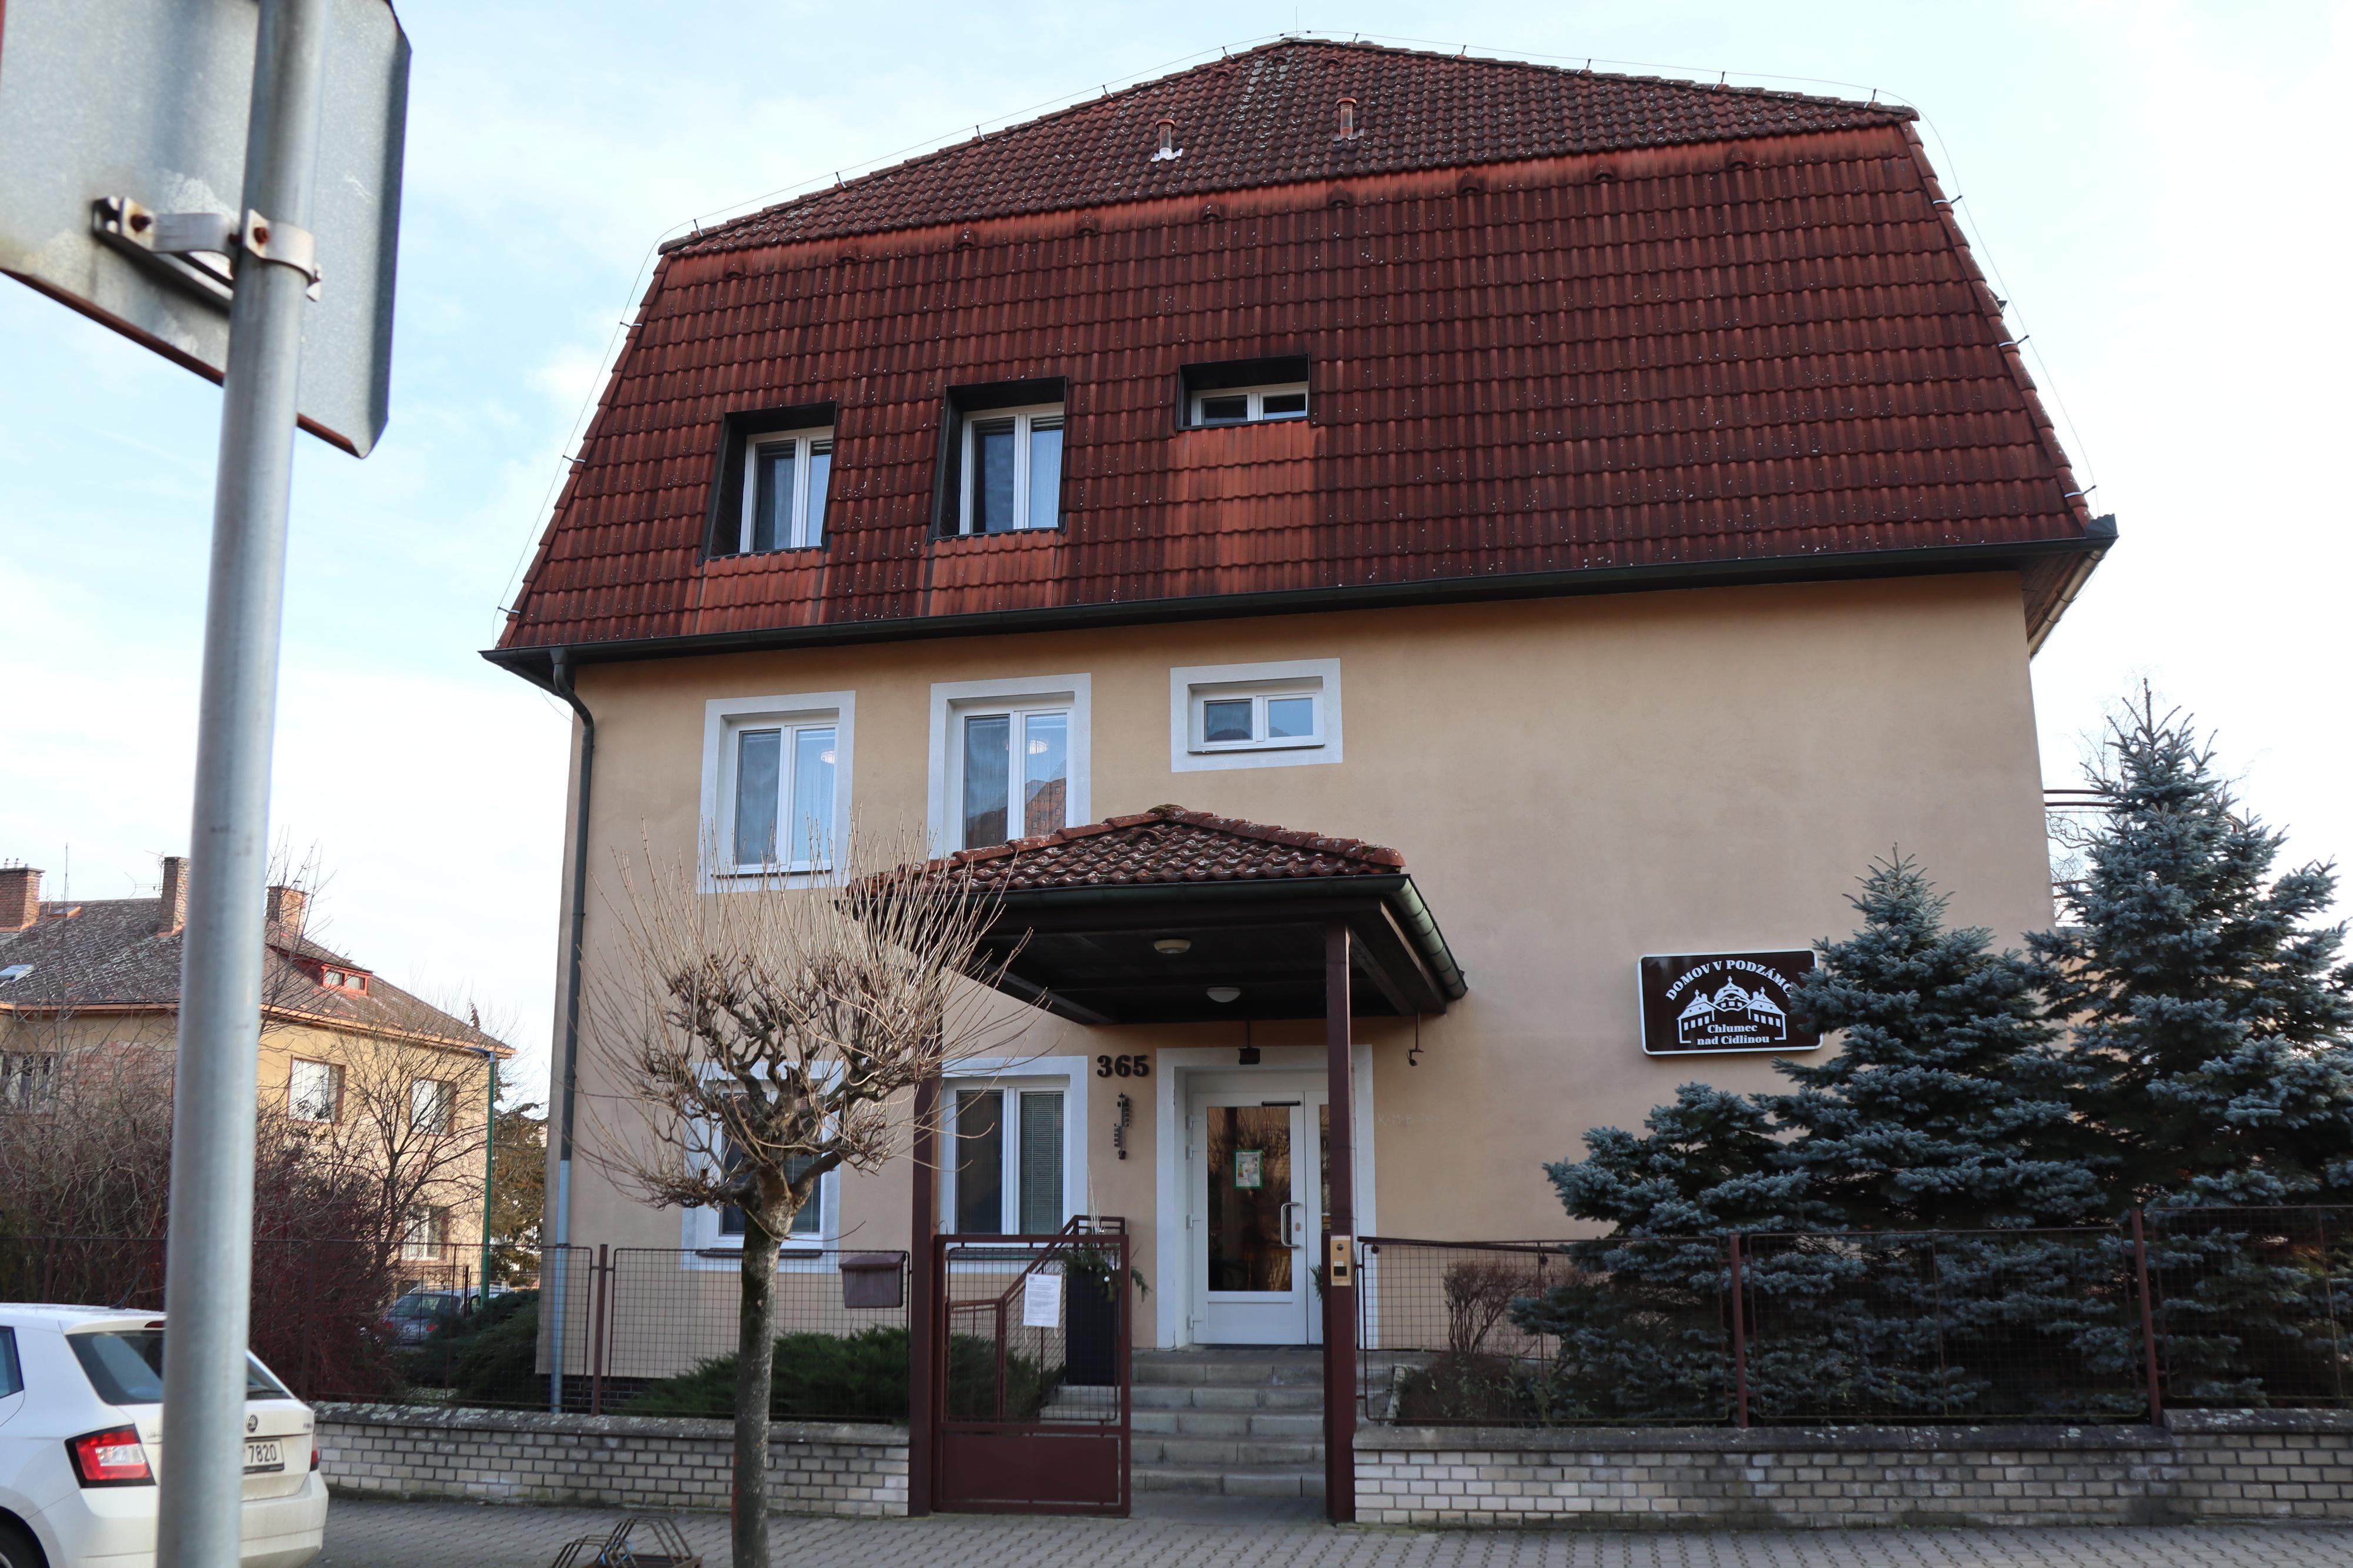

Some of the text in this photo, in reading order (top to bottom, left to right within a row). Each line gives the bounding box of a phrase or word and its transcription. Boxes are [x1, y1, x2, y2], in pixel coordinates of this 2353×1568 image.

[1665, 963, 1709, 1000] DOMOV
[1712, 960, 1722, 970] V
[1707, 1024, 1758, 1033] Chlumec
[1697, 1035, 1769, 1045] nad Cidlinou
[1096, 1055, 1149, 1077] 365
[248, 1444, 277, 1463] 7820
